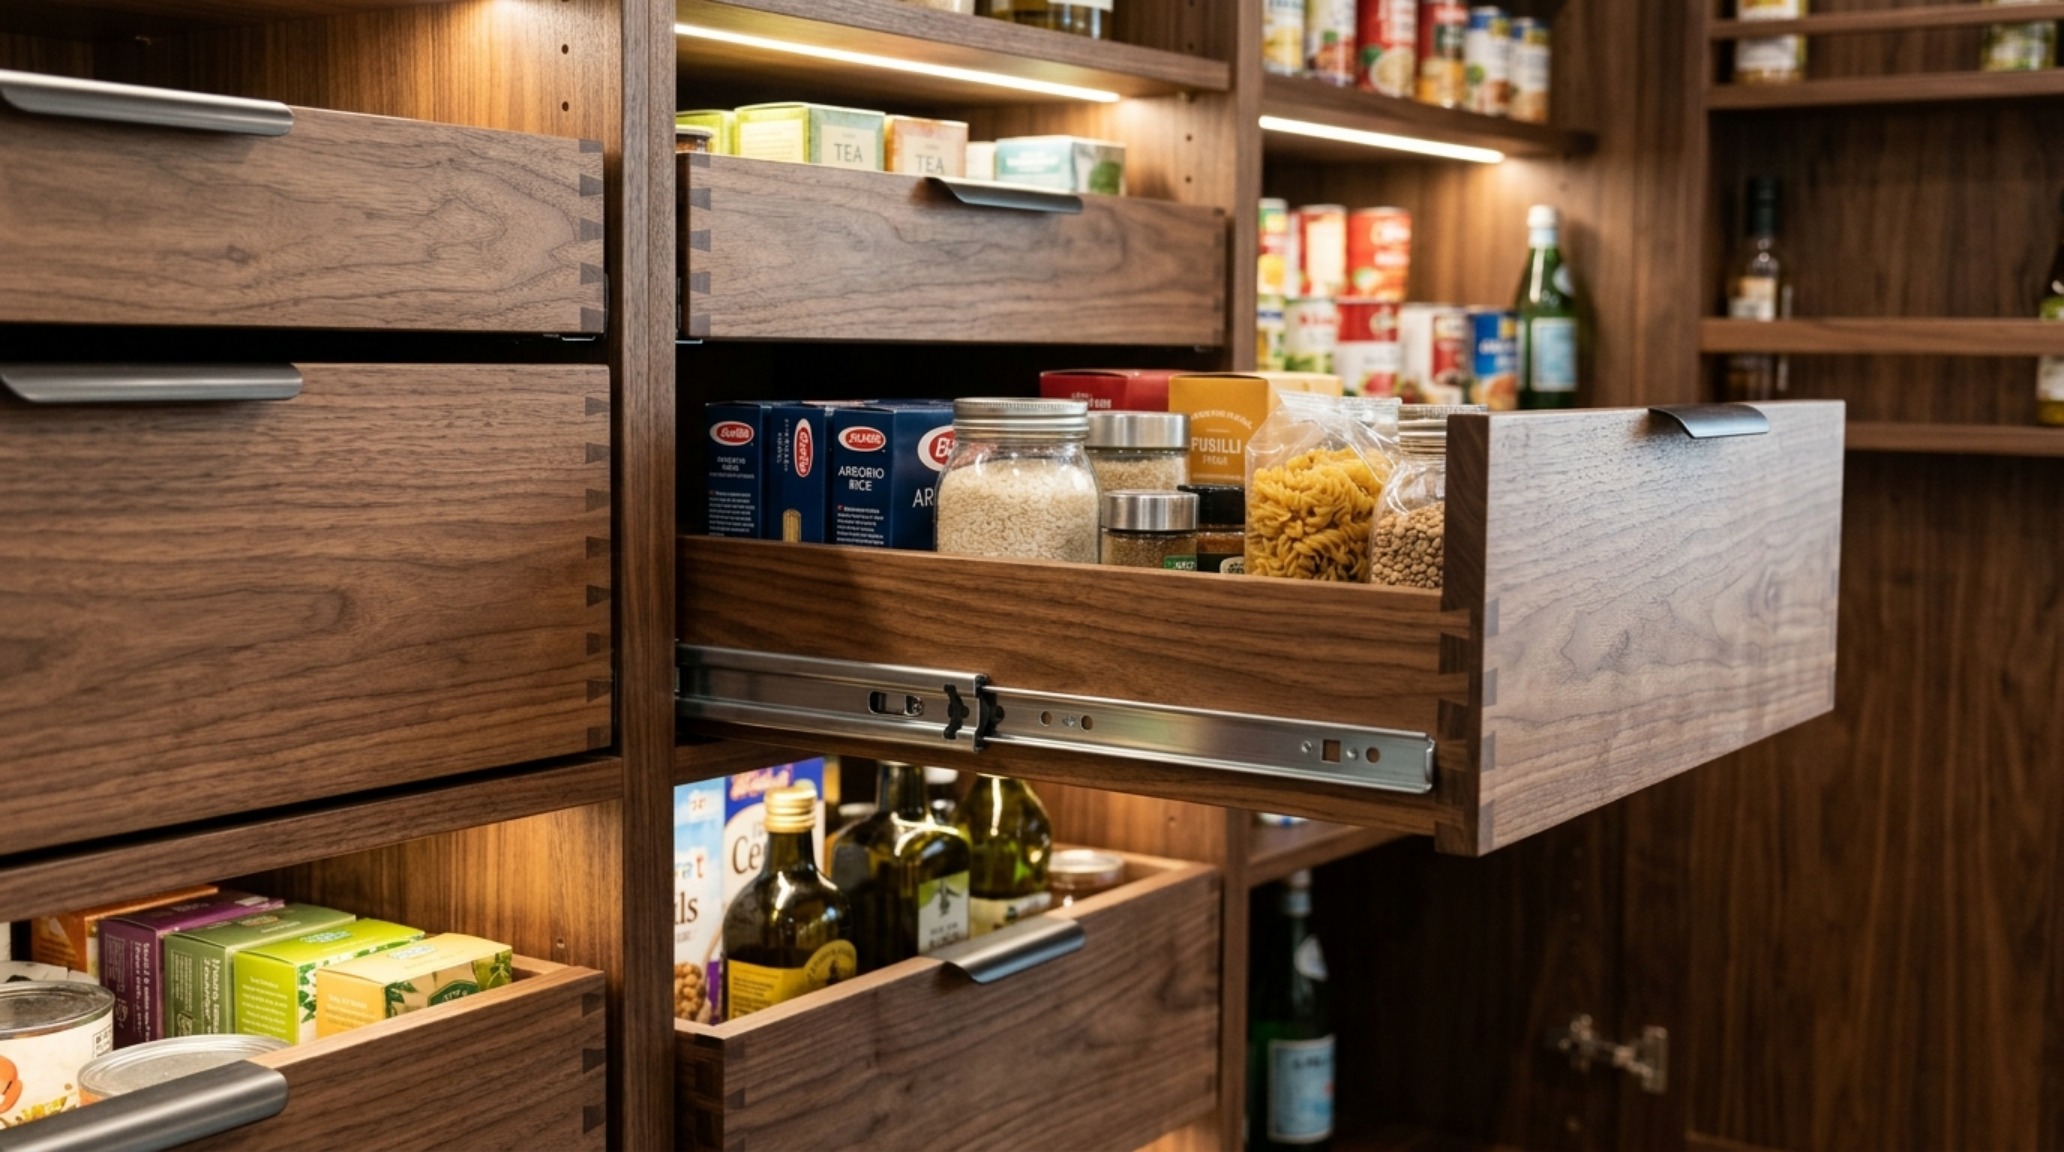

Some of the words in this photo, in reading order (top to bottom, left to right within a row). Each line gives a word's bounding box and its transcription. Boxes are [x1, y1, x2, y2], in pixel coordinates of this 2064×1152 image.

[834, 143, 863, 163] TEA
[915, 154, 945, 174] TEA
[1191, 437, 1241, 454] FUSILLI
[675, 891, 698, 926] ls
